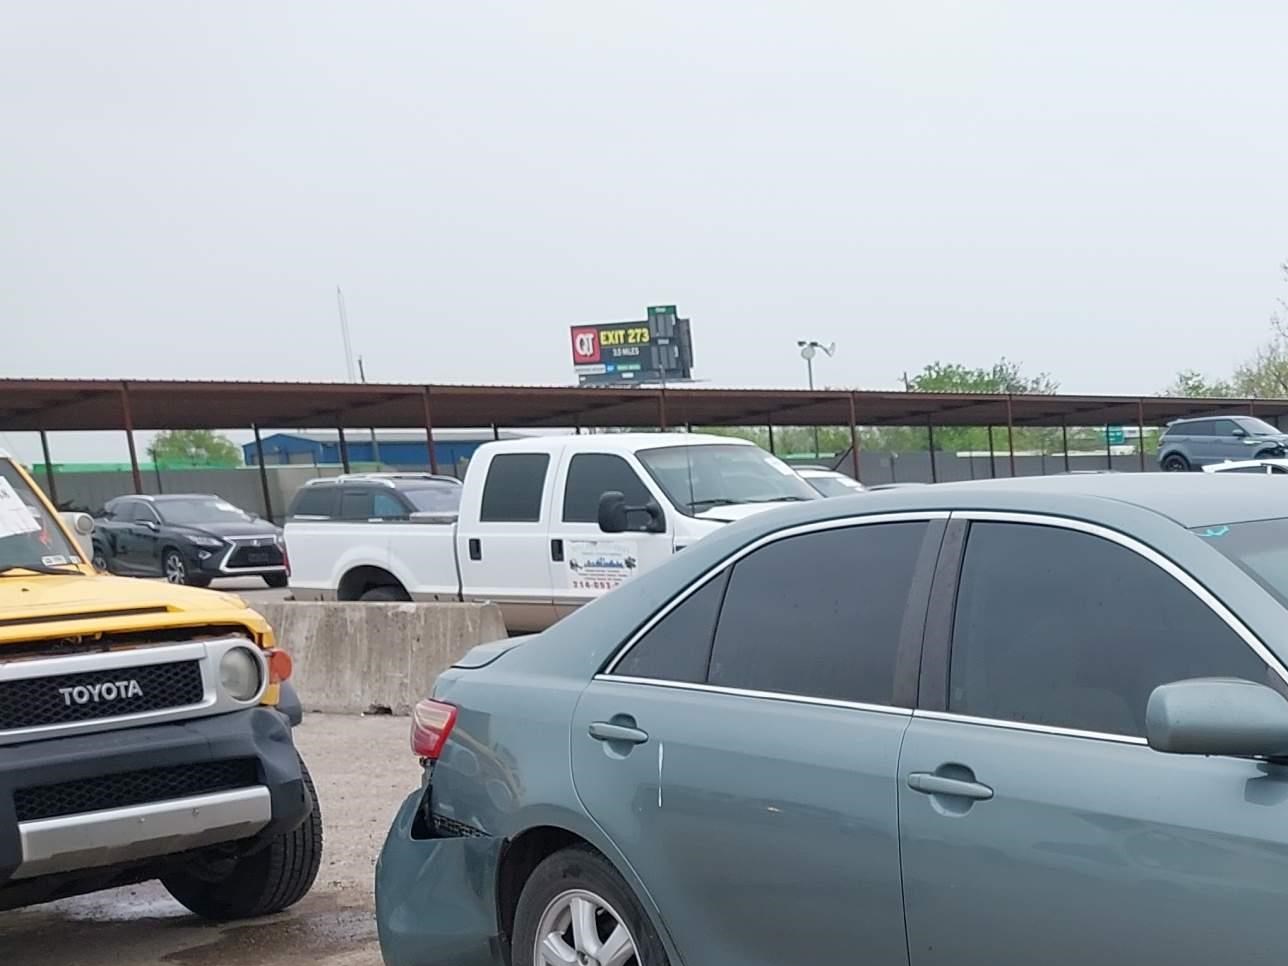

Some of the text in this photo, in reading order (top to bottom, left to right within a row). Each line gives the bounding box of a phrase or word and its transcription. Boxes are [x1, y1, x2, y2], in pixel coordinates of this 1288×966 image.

[576, 333, 594, 356] QT
[600, 328, 649, 345] EXIT 273
[59, 680, 143, 705] TOYOTA
